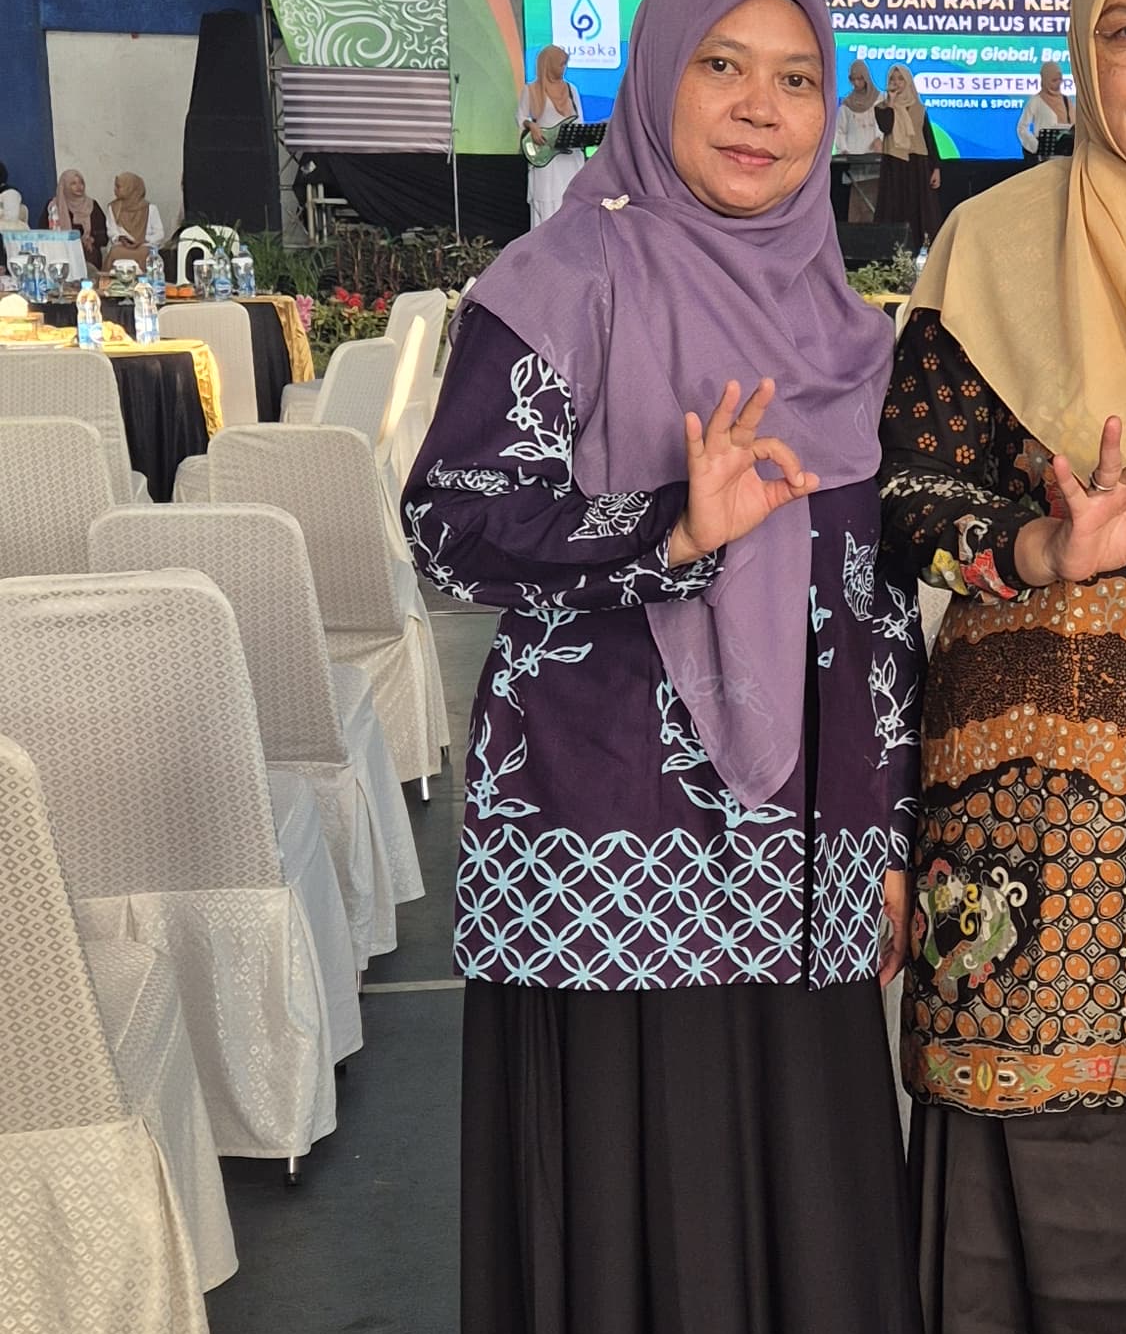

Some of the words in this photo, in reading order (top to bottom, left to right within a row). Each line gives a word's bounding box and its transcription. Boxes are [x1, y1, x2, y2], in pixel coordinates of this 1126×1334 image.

[831, 12, 898, 29] RASAH
[903, 14, 972, 31] ALIYAH
[977, 15, 1025, 32] PLUS
[562, 43, 617, 57] usaka
[930, 44, 978, 65] Saing
[1041, 48, 1070, 63] Ber
[924, 76, 966, 90] 10-13
[971, 77, 1073, 91] SEPTEMR
[924, 98, 979, 108] AMONGAN
